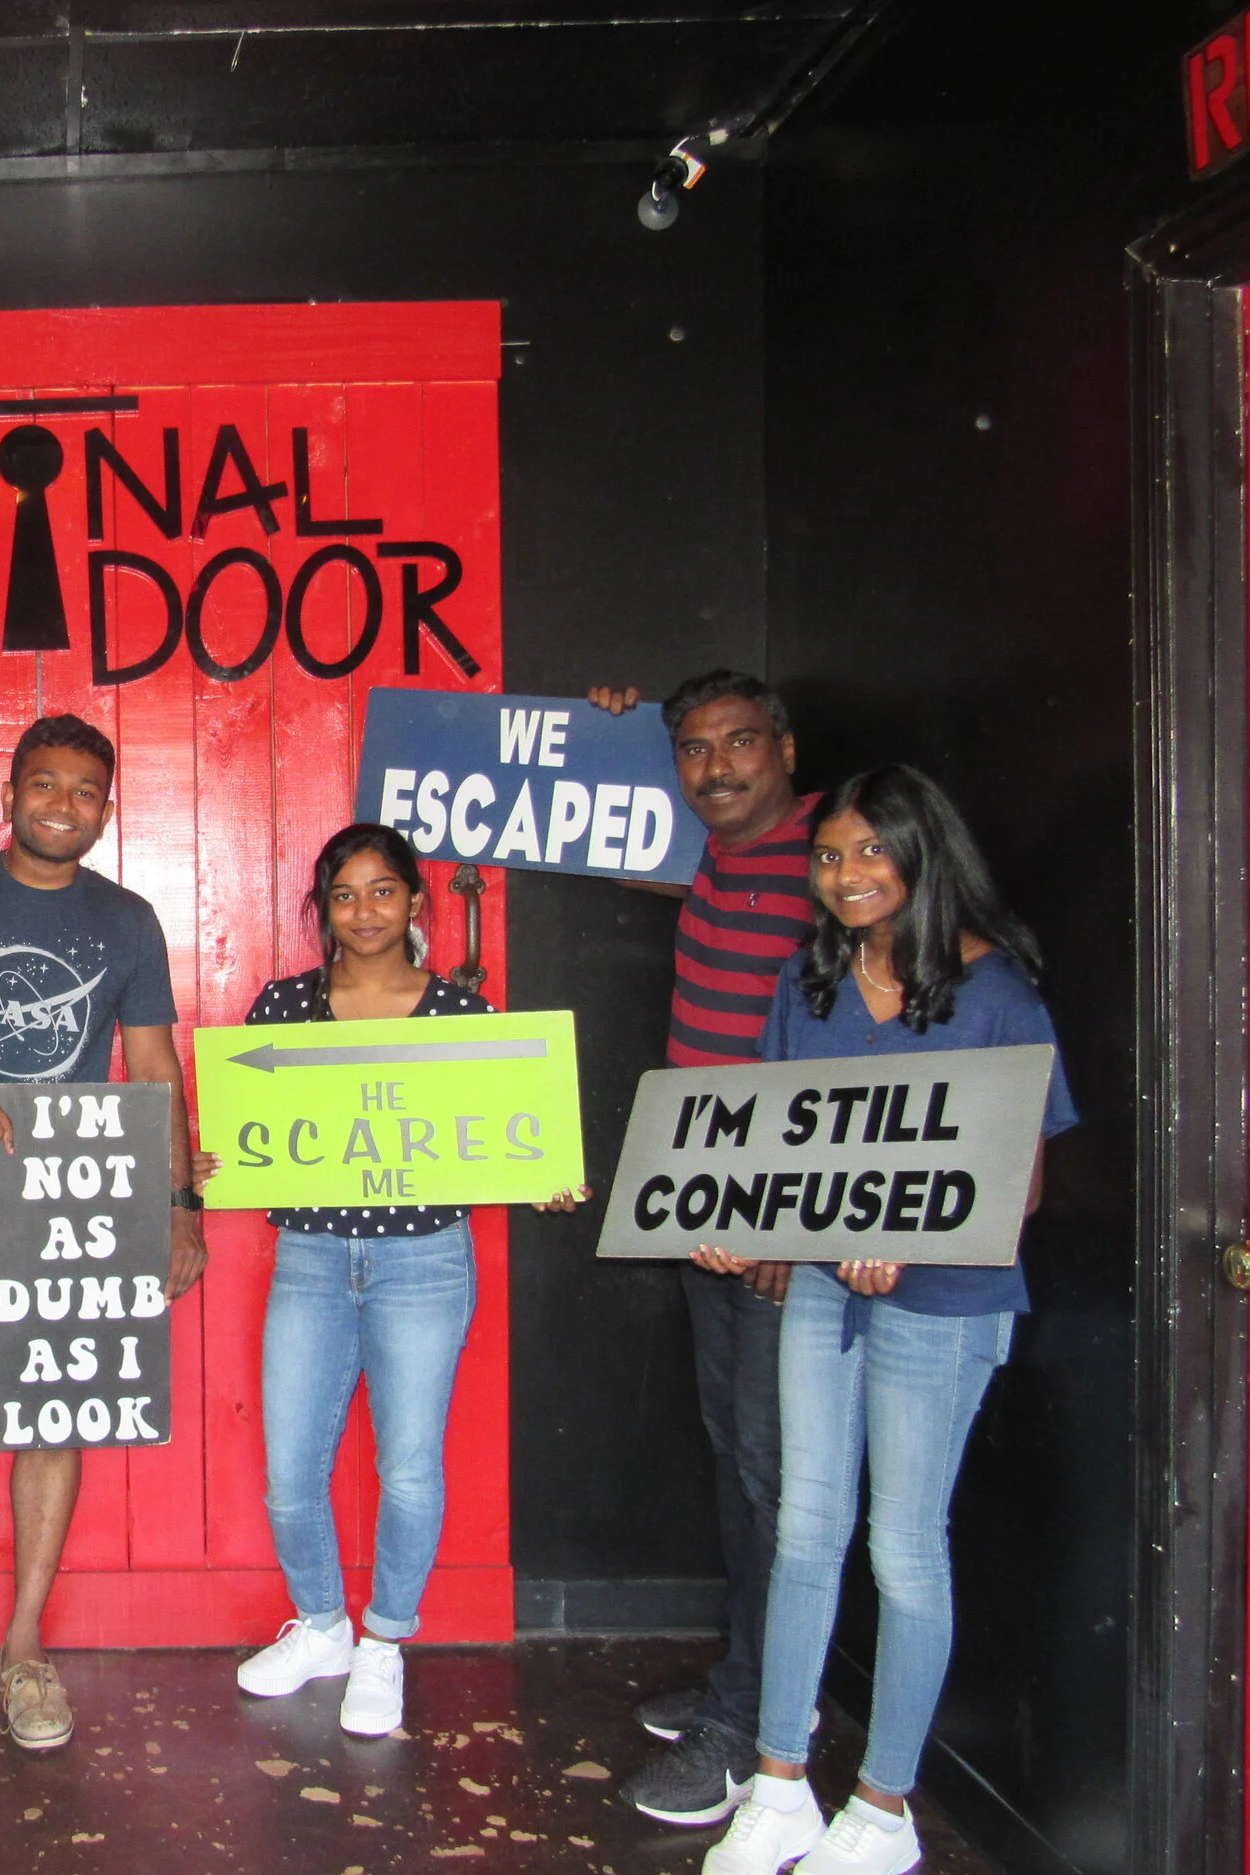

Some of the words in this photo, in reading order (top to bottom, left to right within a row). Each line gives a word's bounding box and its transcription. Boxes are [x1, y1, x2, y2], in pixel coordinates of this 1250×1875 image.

[1189, 11, 1250, 170] R
[87, 541, 482, 687] DOOR
[499, 708, 570, 768] WE
[379, 768, 673, 872] ESCAPED
[32, 1095, 125, 1138] I'M
[360, 1081, 407, 1112] HE
[672, 1092, 758, 1149] I'M
[781, 1082, 959, 1147] STILL
[237, 1112, 544, 1168] SCARES
[21, 1155, 136, 1200] NOT
[362, 1169, 417, 1198] ME
[634, 1169, 976, 1232] CONFUSED
[40, 1215, 117, 1260] AS
[20, 1337, 99, 1383] AS
[118, 1336, 142, 1380] I
[2, 1397, 160, 1445] LOOK
